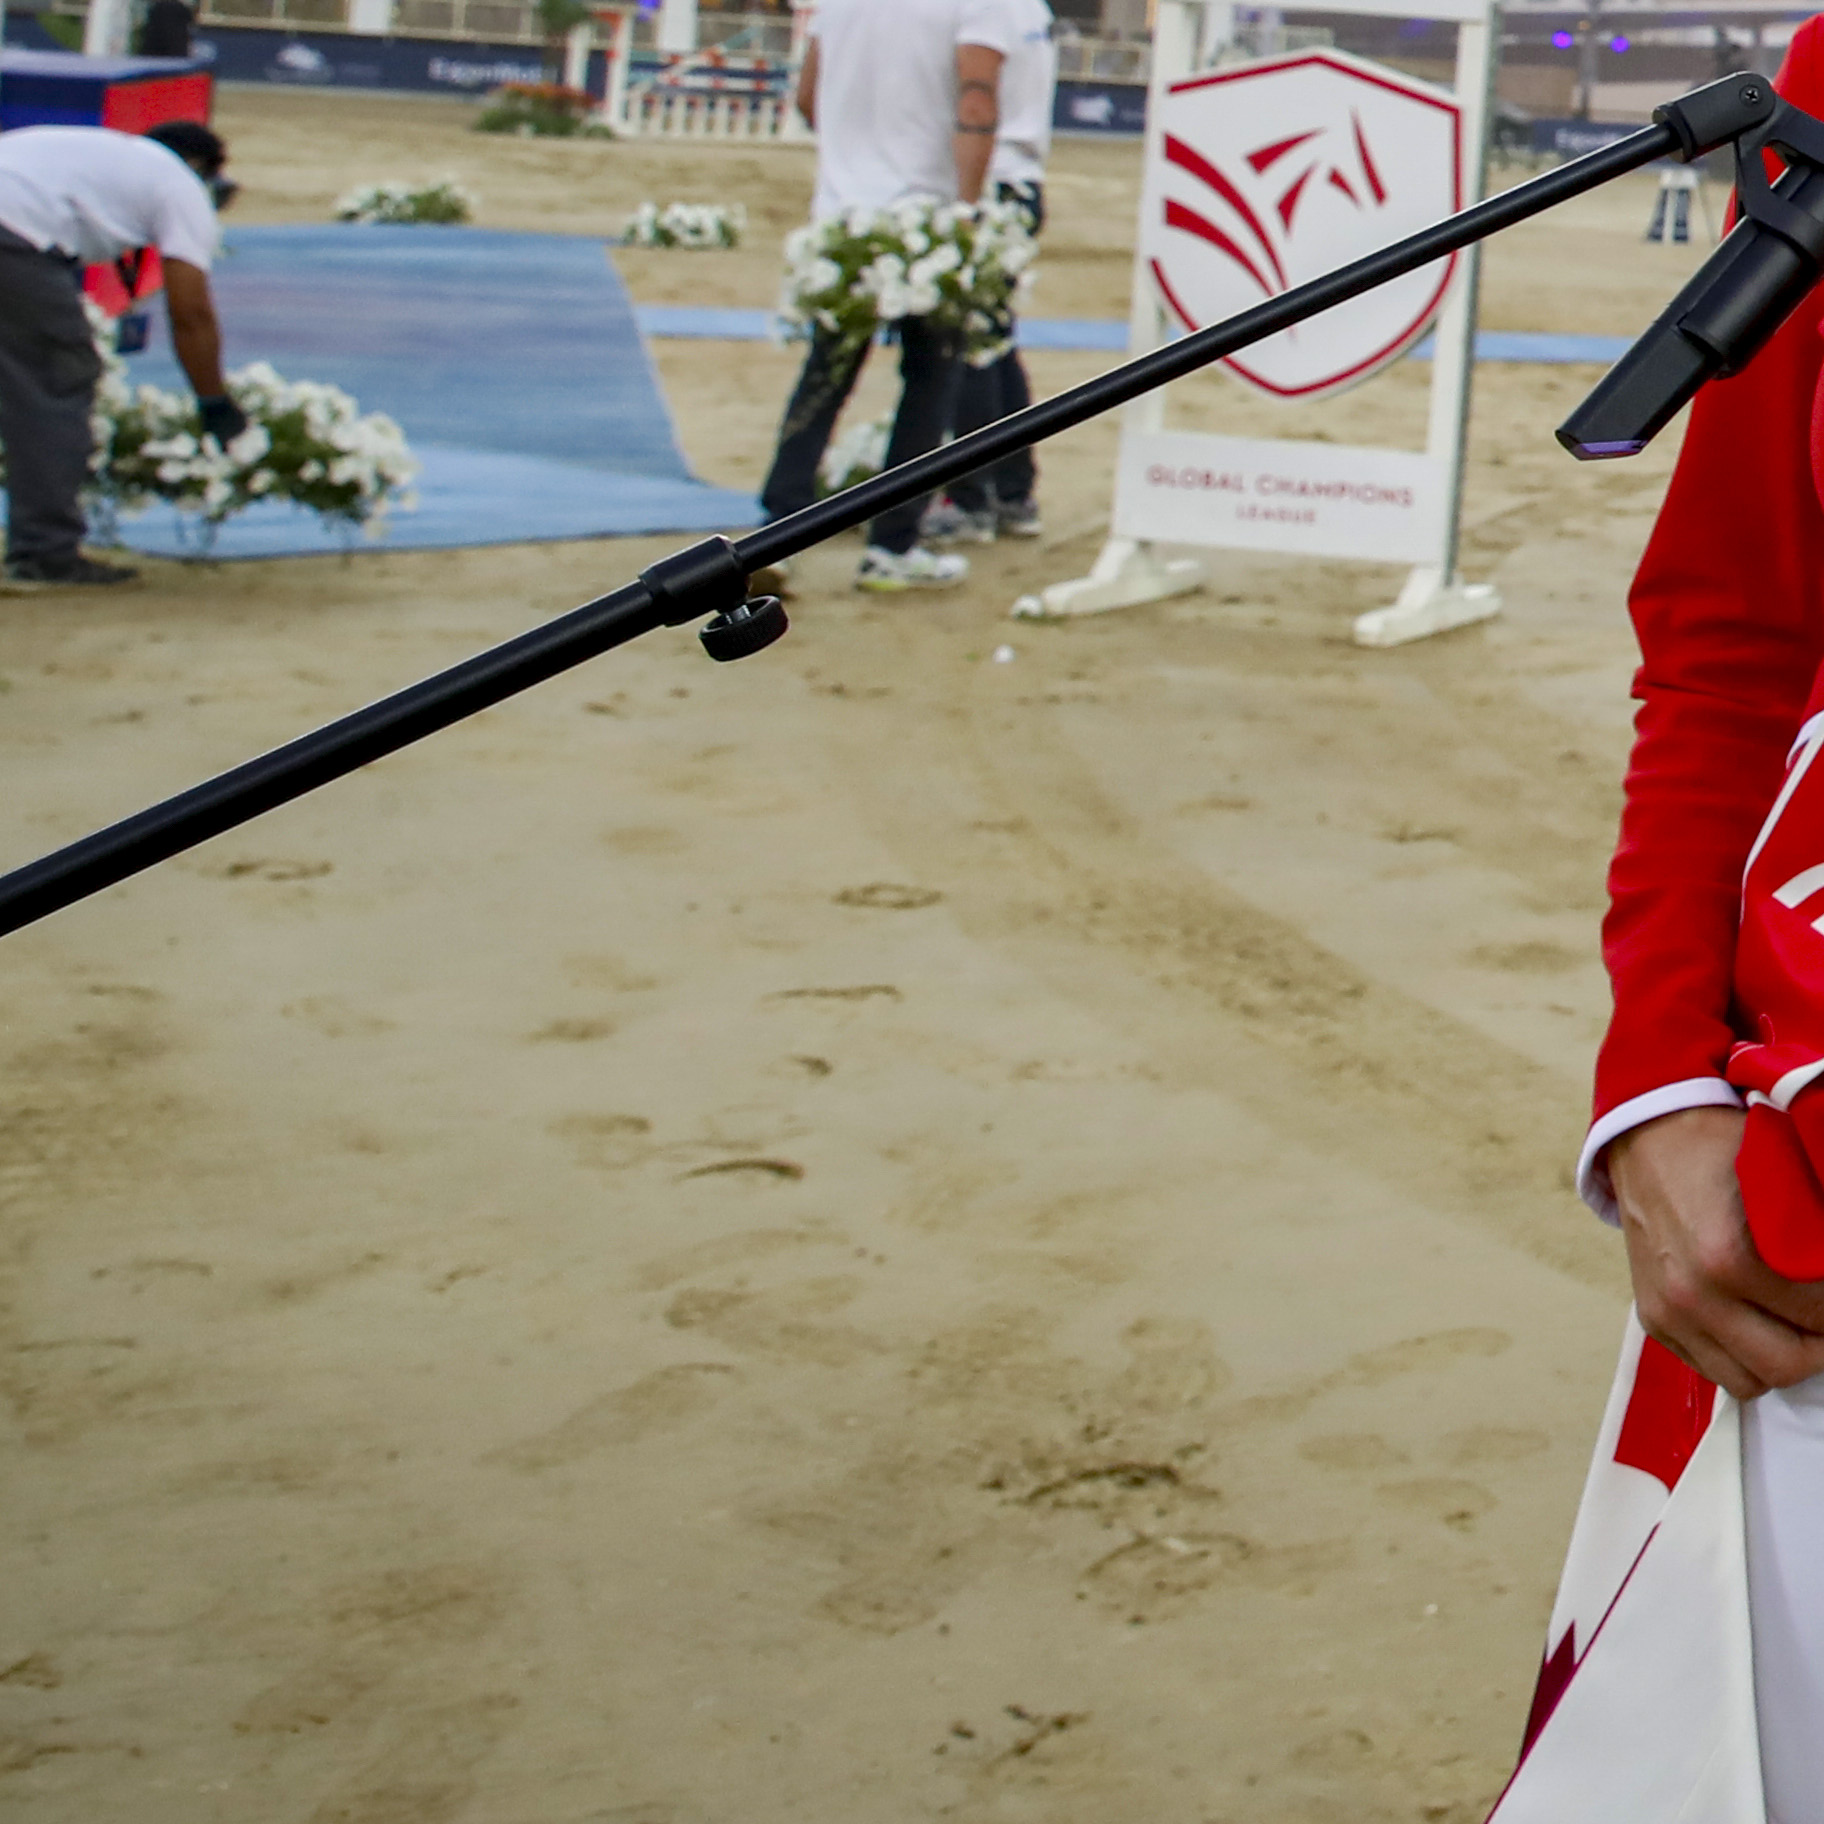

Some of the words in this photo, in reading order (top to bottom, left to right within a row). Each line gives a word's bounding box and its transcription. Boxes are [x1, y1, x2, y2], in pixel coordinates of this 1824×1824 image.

[1145, 464, 1244, 493] GLOBAL
[1254, 474, 1414, 507] CHAMPIONS
[1236, 504, 1316, 524] LEAGUE
